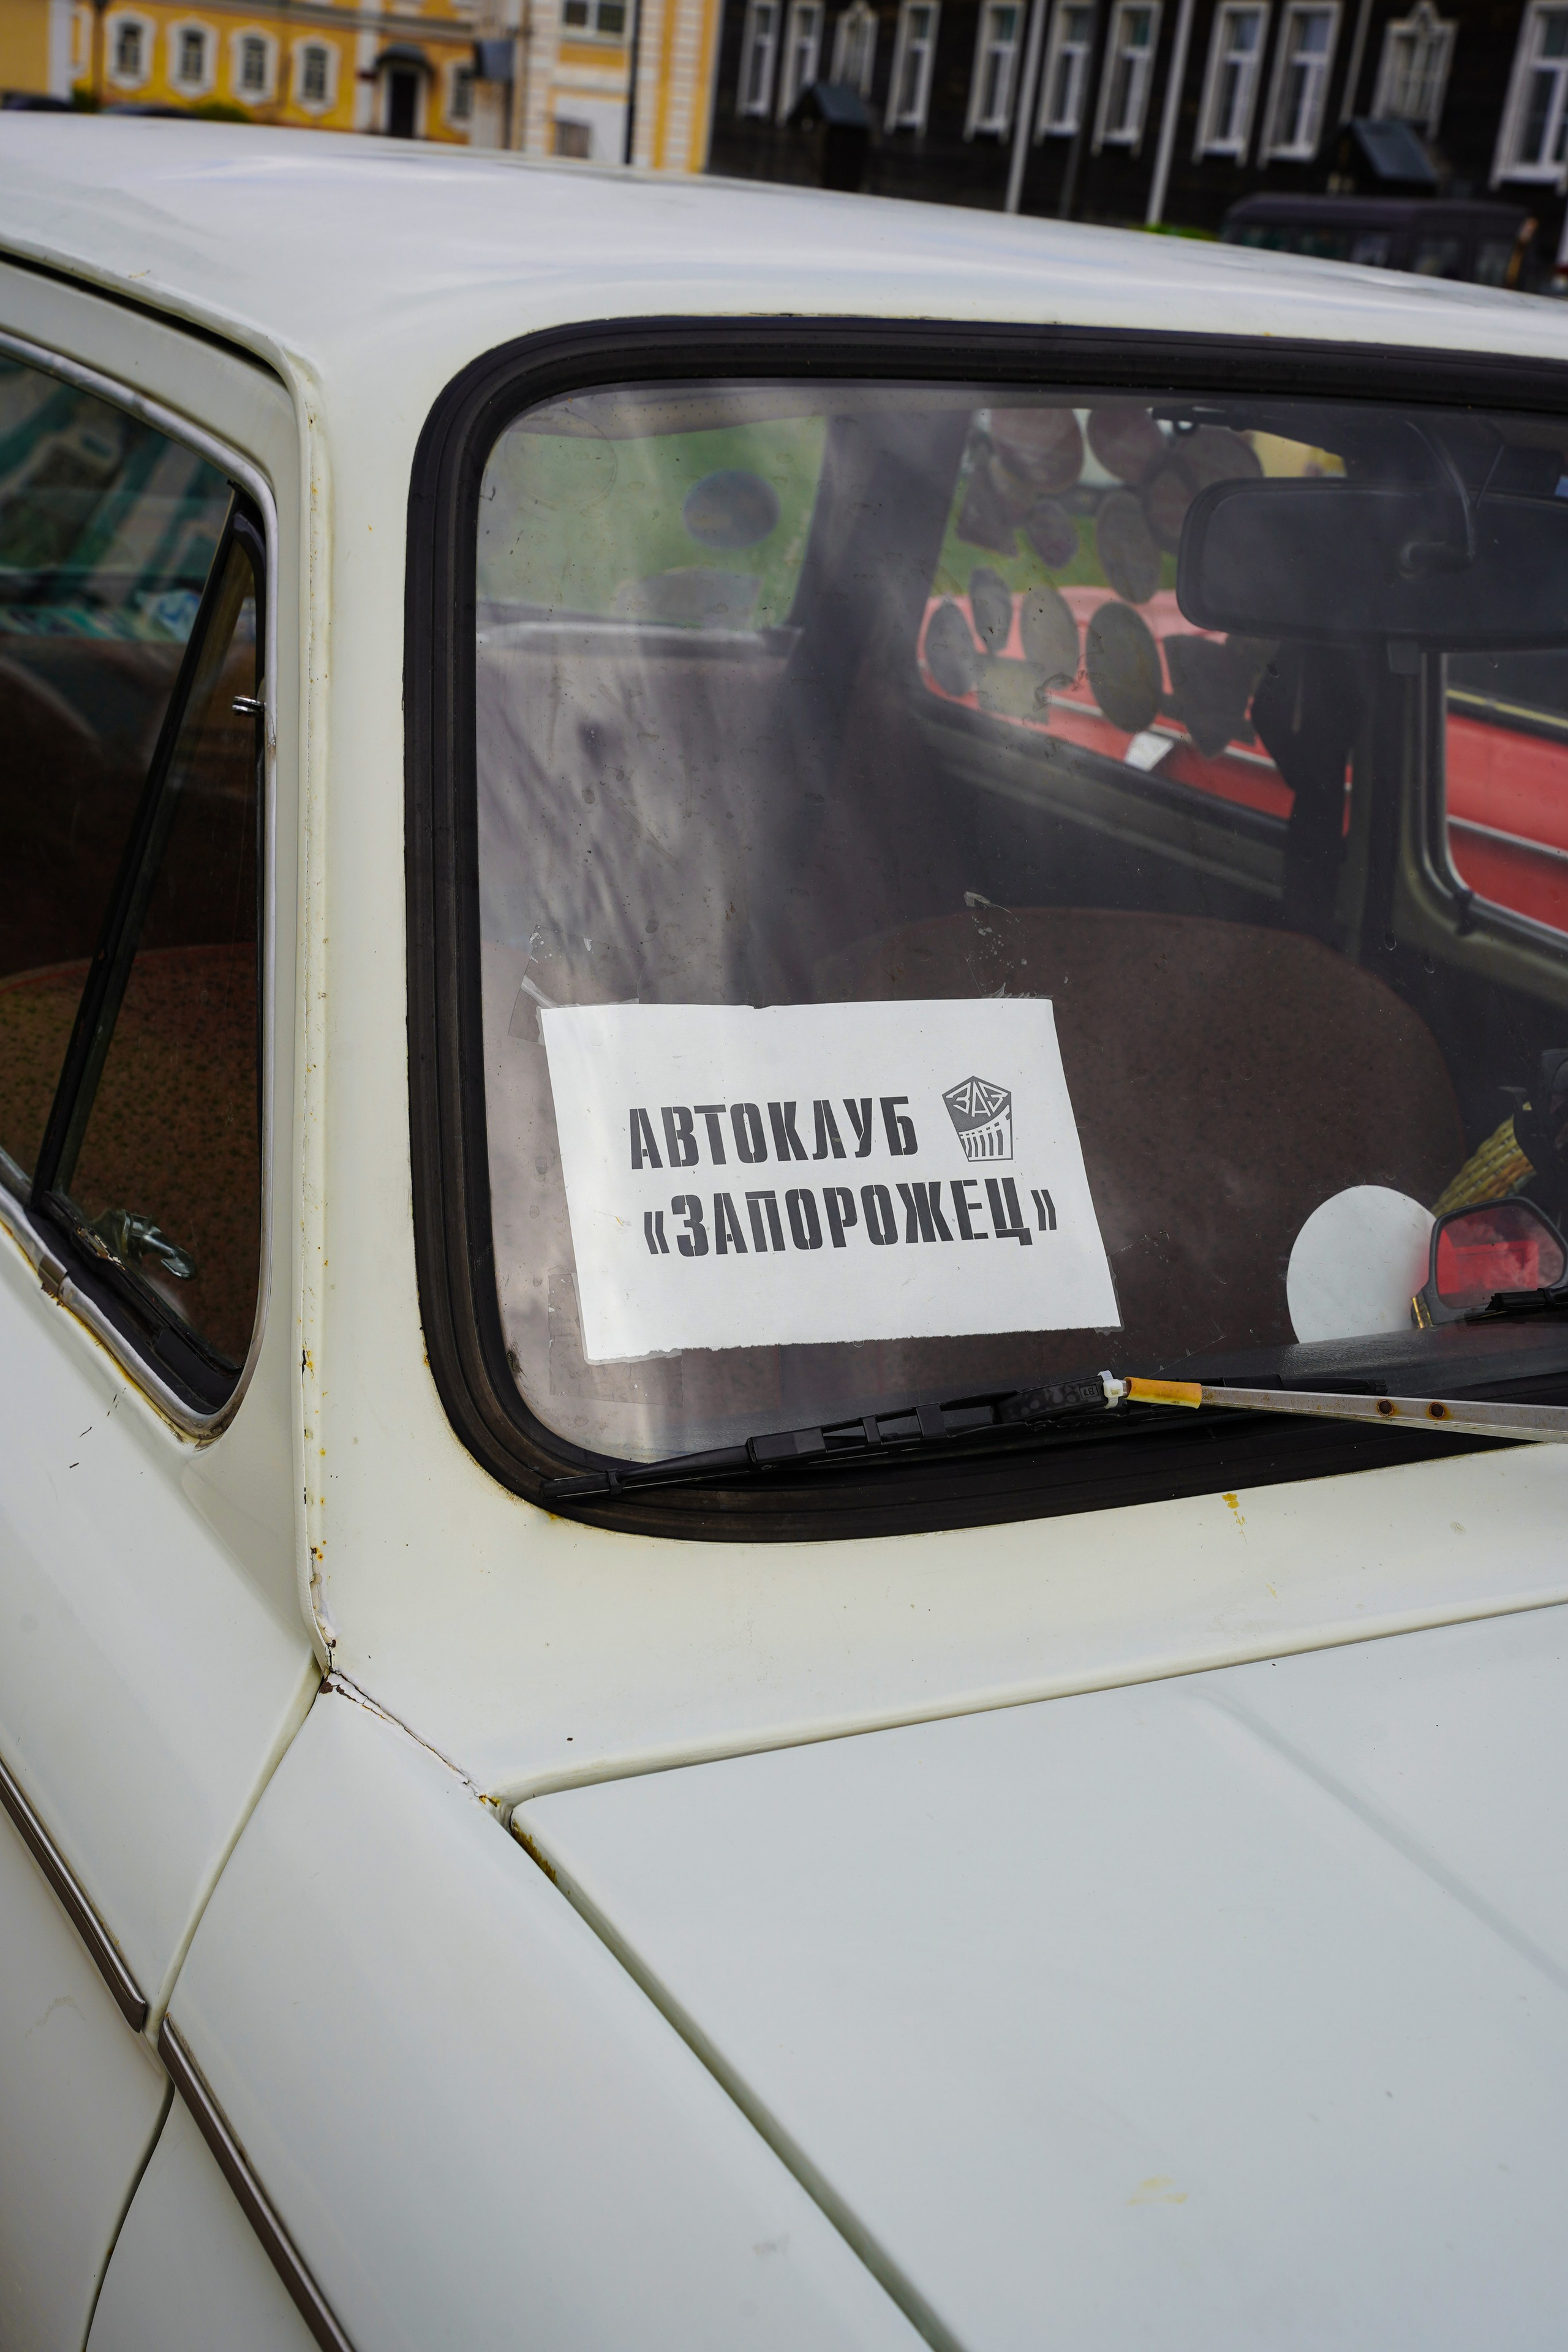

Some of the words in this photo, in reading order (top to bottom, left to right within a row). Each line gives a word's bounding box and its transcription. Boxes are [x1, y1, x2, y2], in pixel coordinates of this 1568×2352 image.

[630, 1096, 918, 1170] АВТОКЛУБ
[946, 1081, 1008, 1118] ЗАЗ
[644, 1177, 1057, 1257] «ЗАПОРОЖЕЦ»
